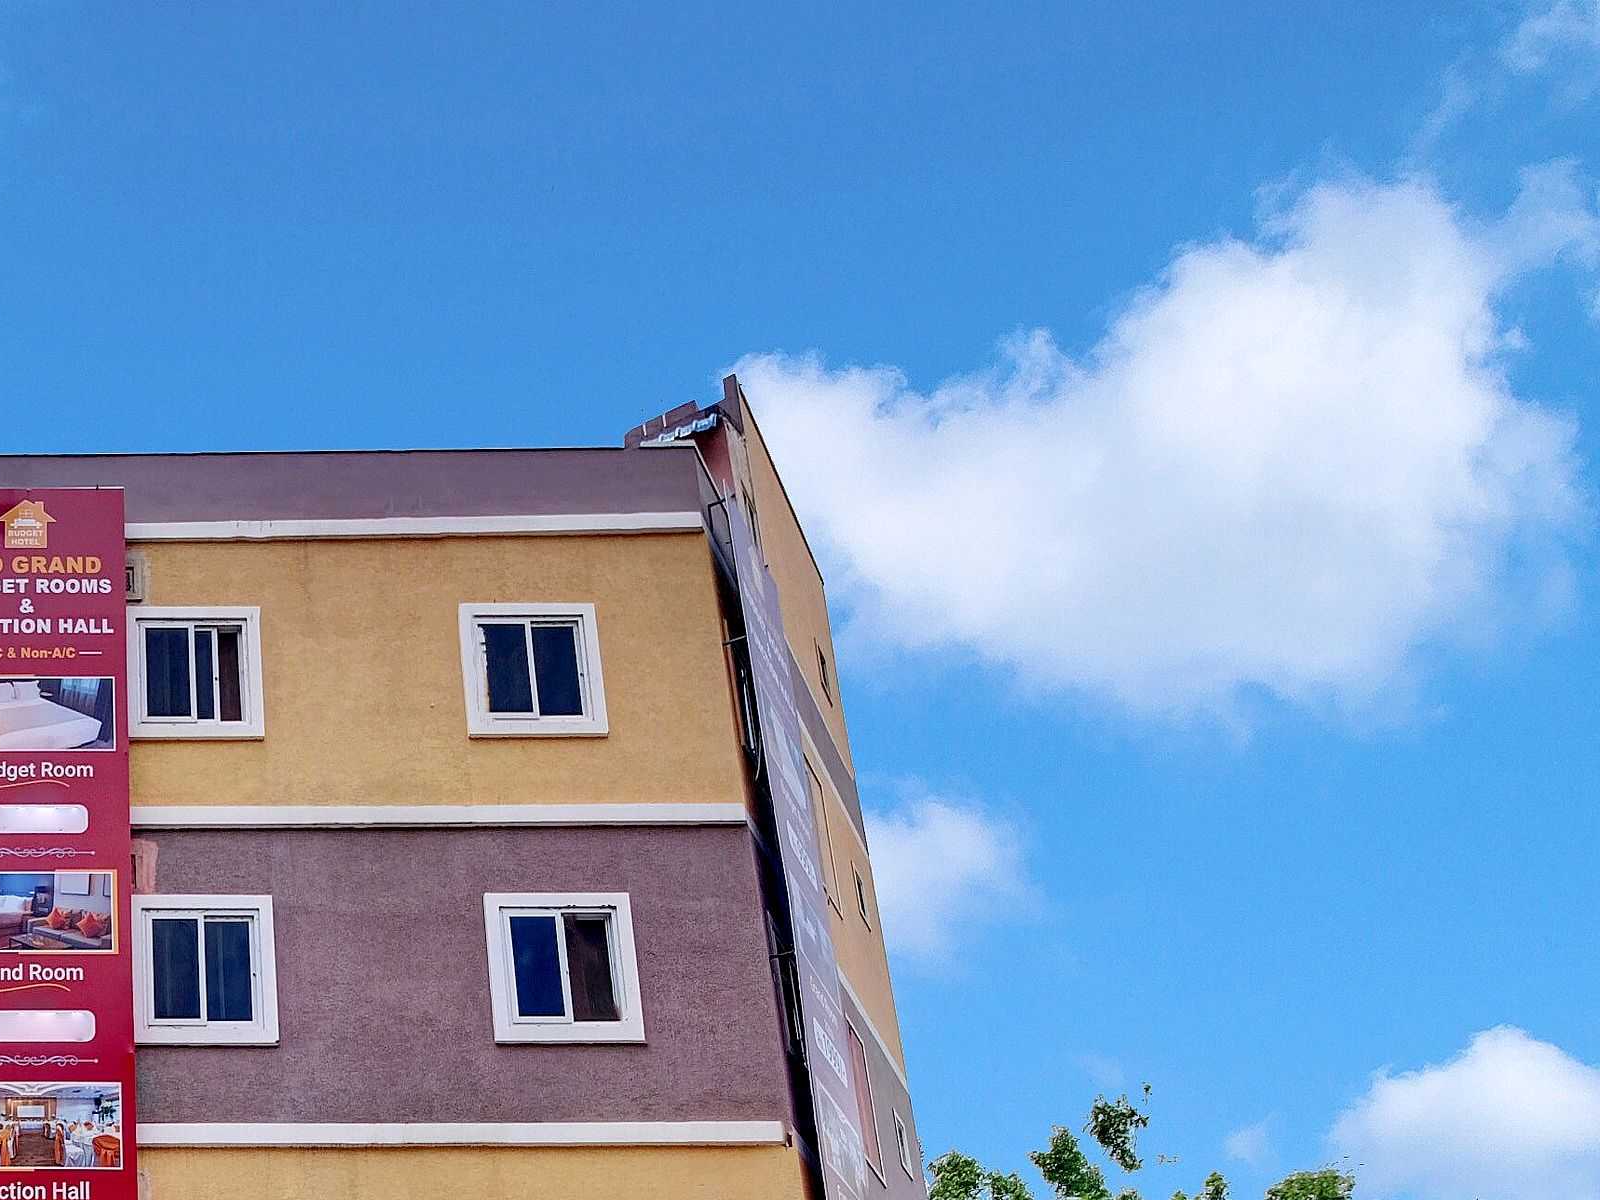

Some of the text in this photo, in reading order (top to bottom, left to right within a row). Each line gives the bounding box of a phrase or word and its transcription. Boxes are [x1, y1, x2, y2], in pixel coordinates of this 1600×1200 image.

[8, 529, 44, 537] BUDGET
[10, 538, 41, 546] HOTEL
[12, 556, 102, 574] GRAND
[35, 578, 112, 594] ROOMS
[19, 598, 34, 614] &
[58, 618, 114, 634] HALL
[7, 648, 16, 659] &
[21, 647, 76, 659] Non-A/C
[40, 763, 94, 778] Room
[29, 964, 84, 981] Room
[52, 1181, 90, 1200] Hall
